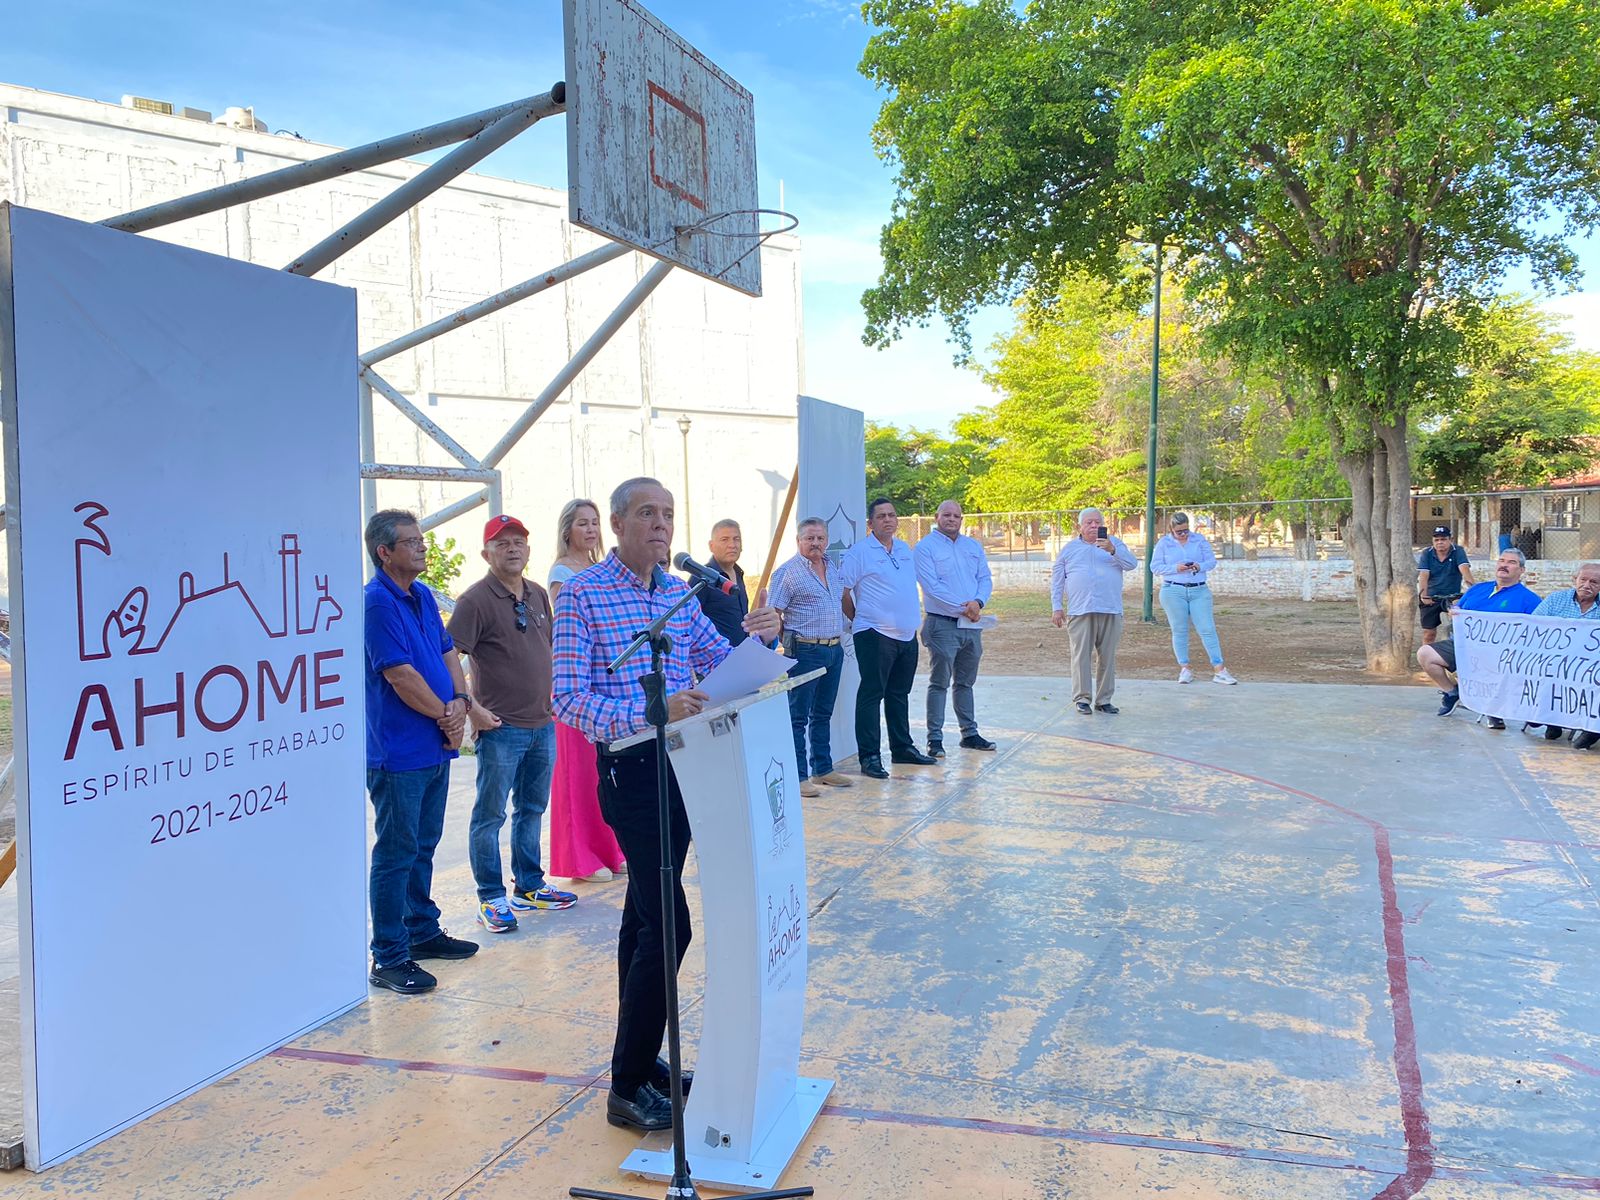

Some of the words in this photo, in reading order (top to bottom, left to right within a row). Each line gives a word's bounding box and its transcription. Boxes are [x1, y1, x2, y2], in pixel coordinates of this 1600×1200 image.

[1464, 616, 1576, 650] SOLICITAMOS
[64, 649, 344, 761] AHOME
[1520, 679, 1539, 707] AV.
[1551, 683, 1600, 718] HIDAL
[63, 756, 192, 805] ESPÍRITU
[205, 747, 234, 772] DE
[248, 723, 345, 761] TRABAJO
[150, 781, 288, 844] 2021-2024
[768, 918, 801, 972] AHOME
